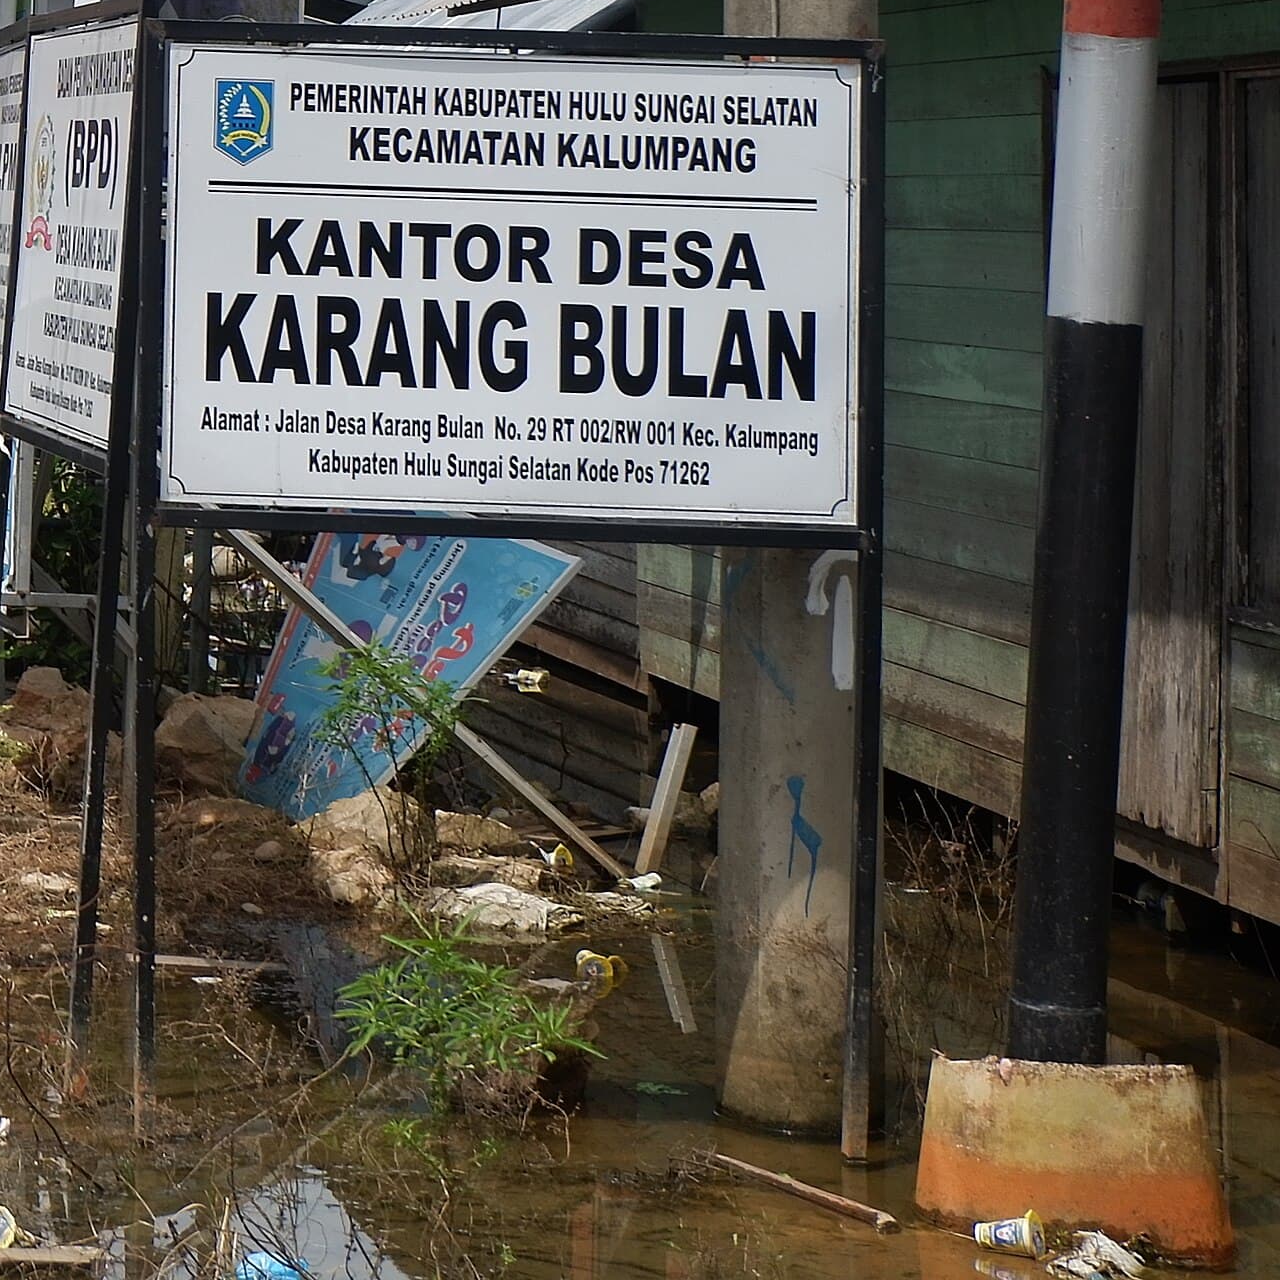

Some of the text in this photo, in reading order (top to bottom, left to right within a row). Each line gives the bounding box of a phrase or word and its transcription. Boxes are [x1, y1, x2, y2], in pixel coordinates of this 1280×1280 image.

[290, 82, 818, 127] PEMERINTAH KABUPATEN HULU SUNGAI SELATAN
[65, 117, 119, 210] (BPD)
[349, 126, 757, 174] KECAMATAN KALUMPANG
[256, 217, 766, 291] KANTOR DESA
[205, 291, 817, 402] KARANG BULAN
[201, 406, 260, 432] Alamat
[275, 409, 319, 434] Jalan
[326, 410, 366, 435] Desa
[372, 412, 431, 444] Karang
[438, 414, 483, 440] Bulan
[495, 416, 521, 441] No.
[527, 417, 546, 441] 29
[553, 418, 574, 442] RT
[580, 419, 641, 445] 002/RW
[647, 421, 675, 446] 001
[683, 422, 719, 447] Kec.
[725, 423, 818, 457] Kalumpang
[309, 448, 710, 486] Kabupaten Hulu Sungai Selatan Kode Pos 71262
[432, 541, 464, 584] Skrining
